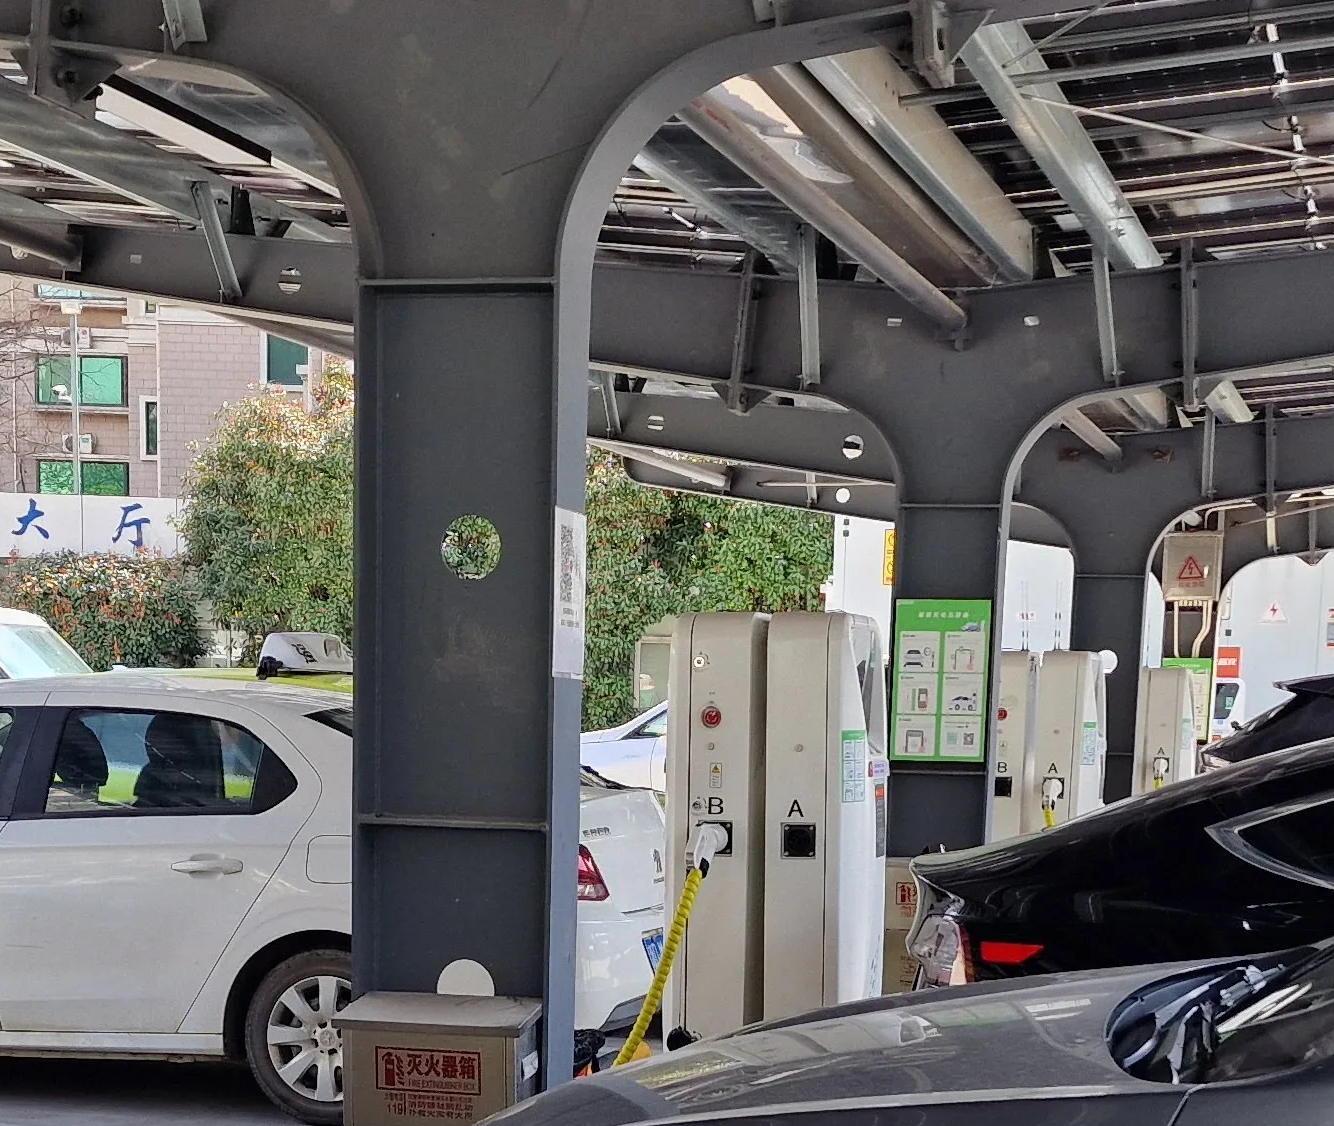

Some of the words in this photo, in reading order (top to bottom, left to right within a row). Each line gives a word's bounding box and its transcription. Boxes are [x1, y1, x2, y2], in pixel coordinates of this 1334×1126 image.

[998, 762, 1008, 773] B
[1047, 762, 1058, 774] A
[707, 797, 724, 815] B
[787, 799, 804, 818] A
[407, 1053, 476, 1080] 灭火器箱
[387, 1103, 403, 1116] 119
